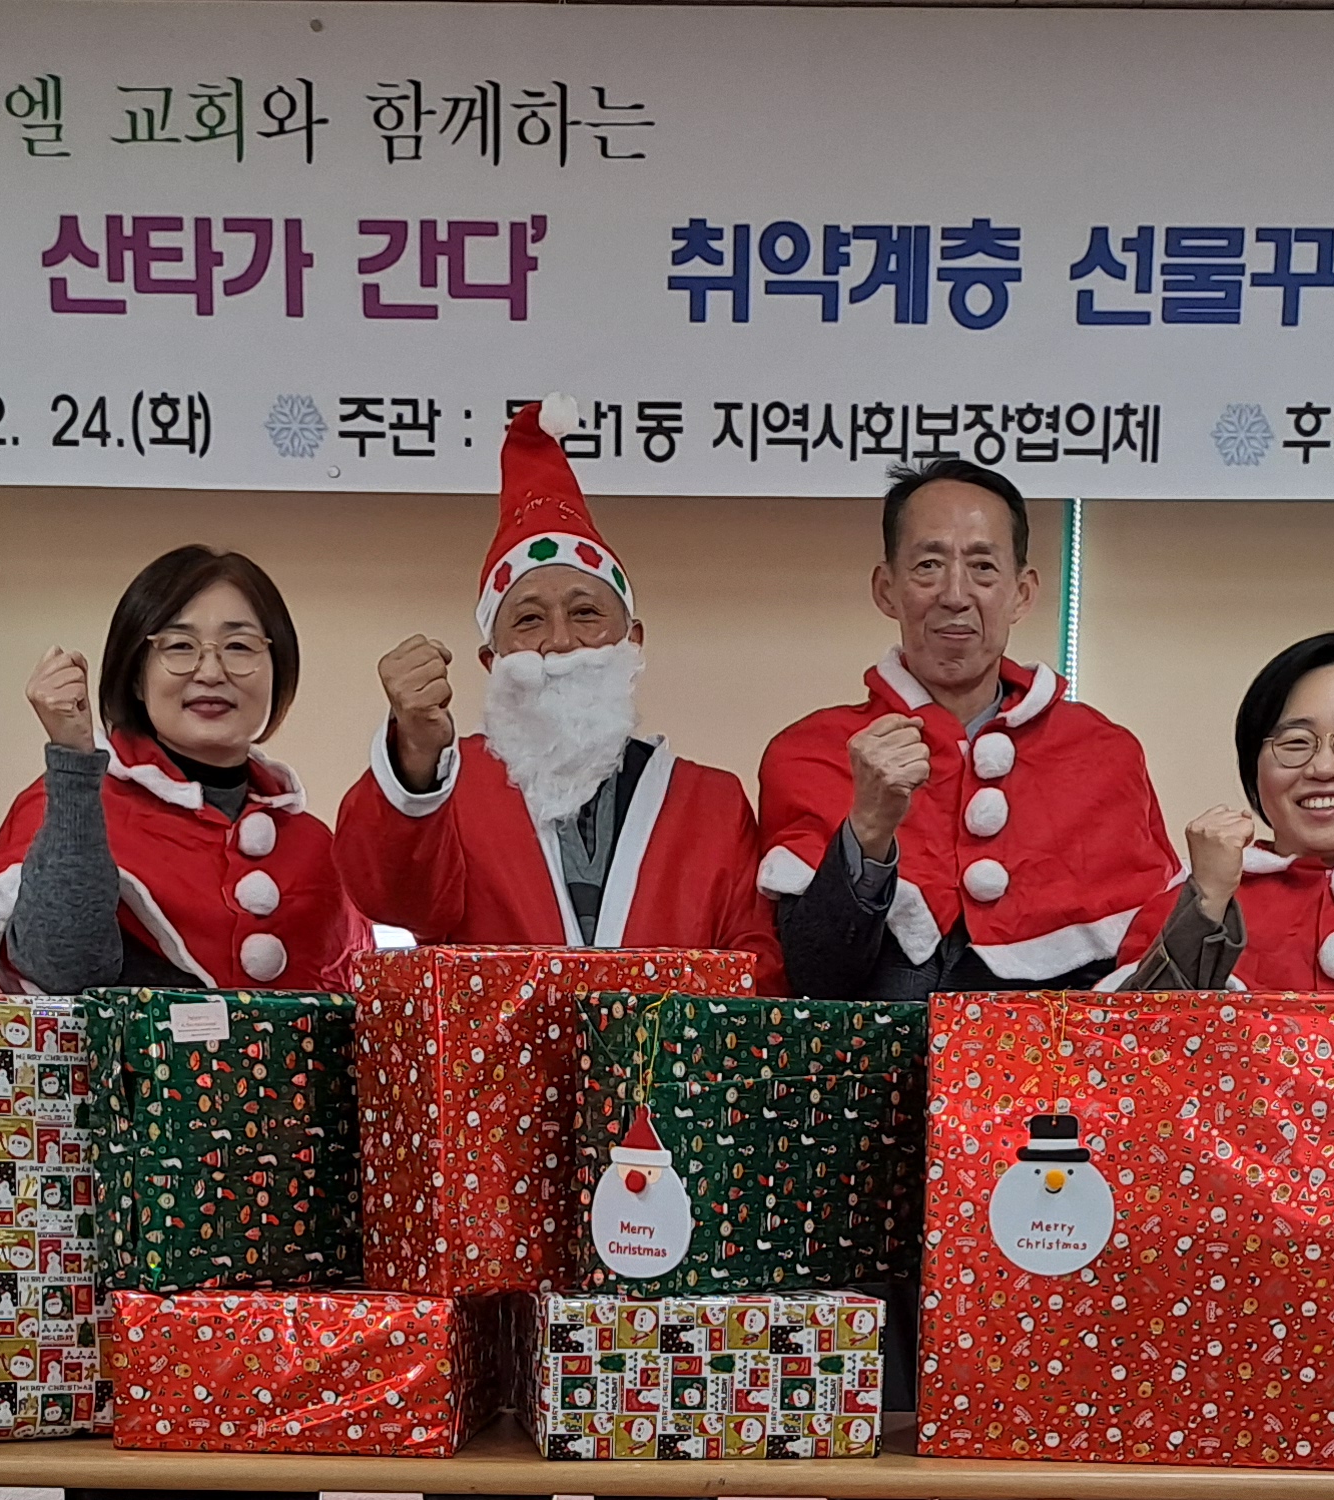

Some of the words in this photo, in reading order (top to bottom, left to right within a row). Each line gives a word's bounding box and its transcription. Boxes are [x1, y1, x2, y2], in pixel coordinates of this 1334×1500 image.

[110, 76, 329, 165] 교회와
[366, 79, 655, 168] 함께하는
[42, 214, 314, 318] 산타가
[667, 217, 1022, 330] 취약계층
[51, 390, 211, 458] 24.(화)
[338, 397, 442, 458] 주관
[713, 401, 1160, 465] 지역사회보장협의체
[609, 1241, 667, 1258] Christmas
[620, 1221, 655, 1239] Merry
[1017, 1238, 1088, 1251] Christmas
[1031, 1221, 1075, 1237] Merry
